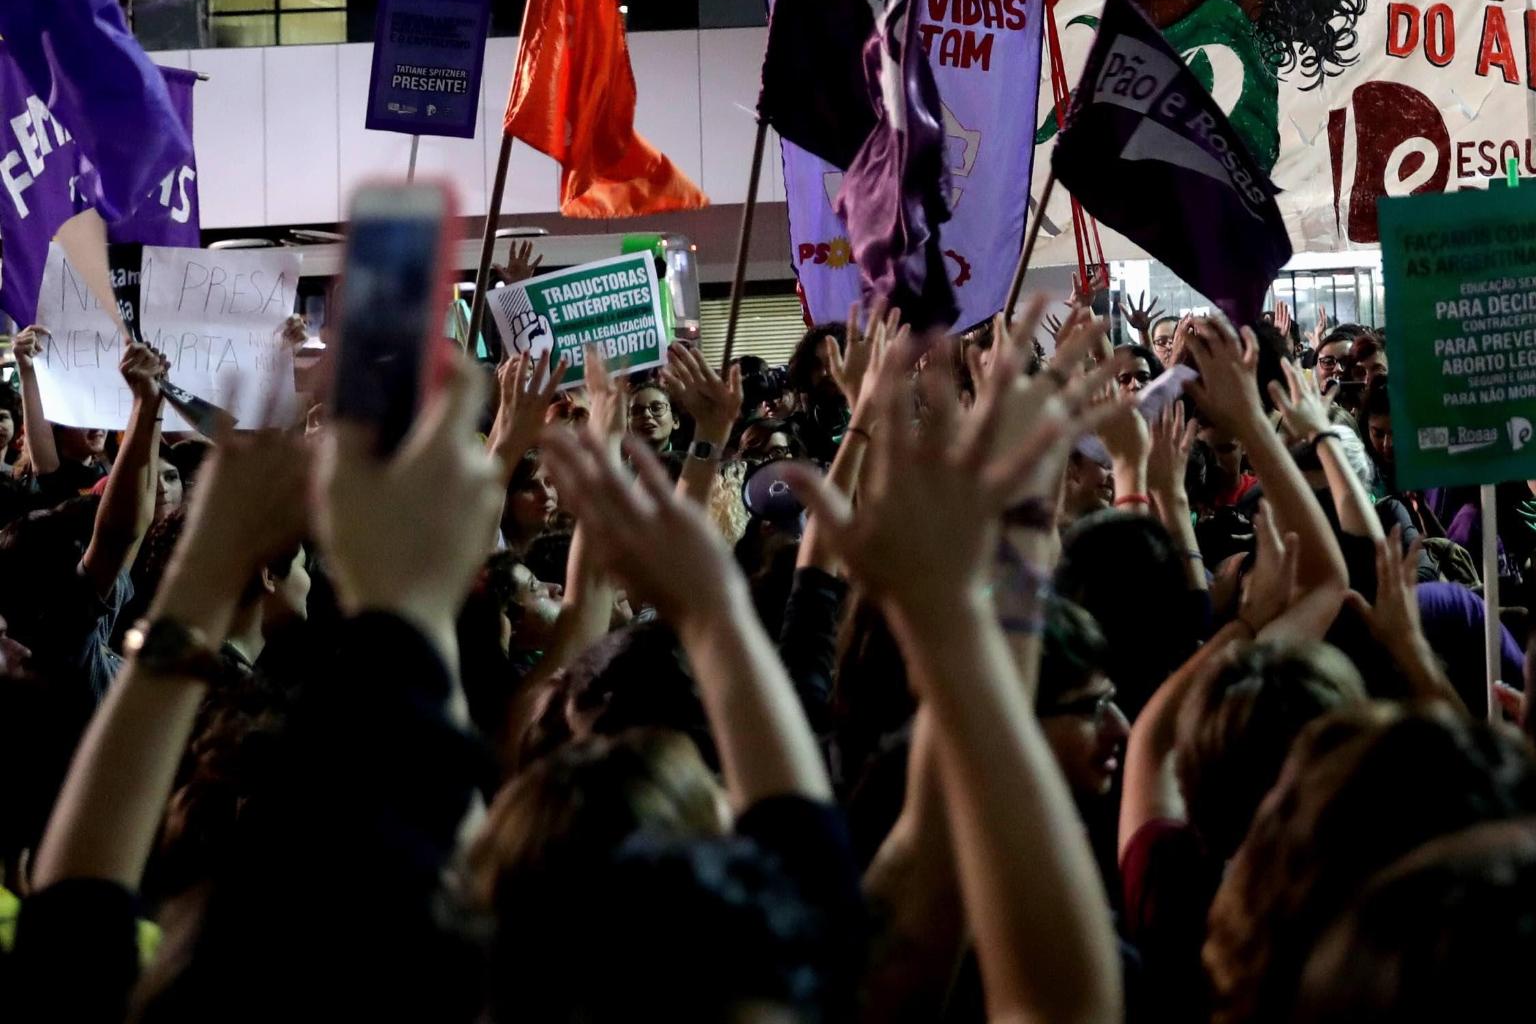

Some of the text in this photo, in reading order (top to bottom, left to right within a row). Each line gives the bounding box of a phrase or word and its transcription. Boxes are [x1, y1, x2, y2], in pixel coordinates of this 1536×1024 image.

[1386, 1, 1456, 66] DO
[391, 75, 467, 94] PRESENTE!
[396, 64, 428, 77] TATIANE
[1096, 52, 1266, 205] Pão e Rosas
[178, 260, 286, 315] PRESA
[541, 267, 648, 305] TRADUCTORAS
[1460, 277, 1516, 296] EDUCAÇÃO
[548, 308, 560, 324] E
[561, 286, 651, 321] INTÉRPRETES
[1435, 297, 1485, 320] PARA
[557, 333, 578, 348] POR
[579, 331, 593, 345] LA
[592, 314, 656, 340] LEGALIZACIÓN
[596, 328, 658, 361] ABORTO
[47, 328, 121, 372] NEM
[1434, 335, 1478, 357] PARA
[1441, 352, 1503, 376] ABORTO
[1467, 374, 1507, 388] SEGURO
[1443, 389, 1478, 407] PARA
[1479, 385, 1506, 405] NÃO
